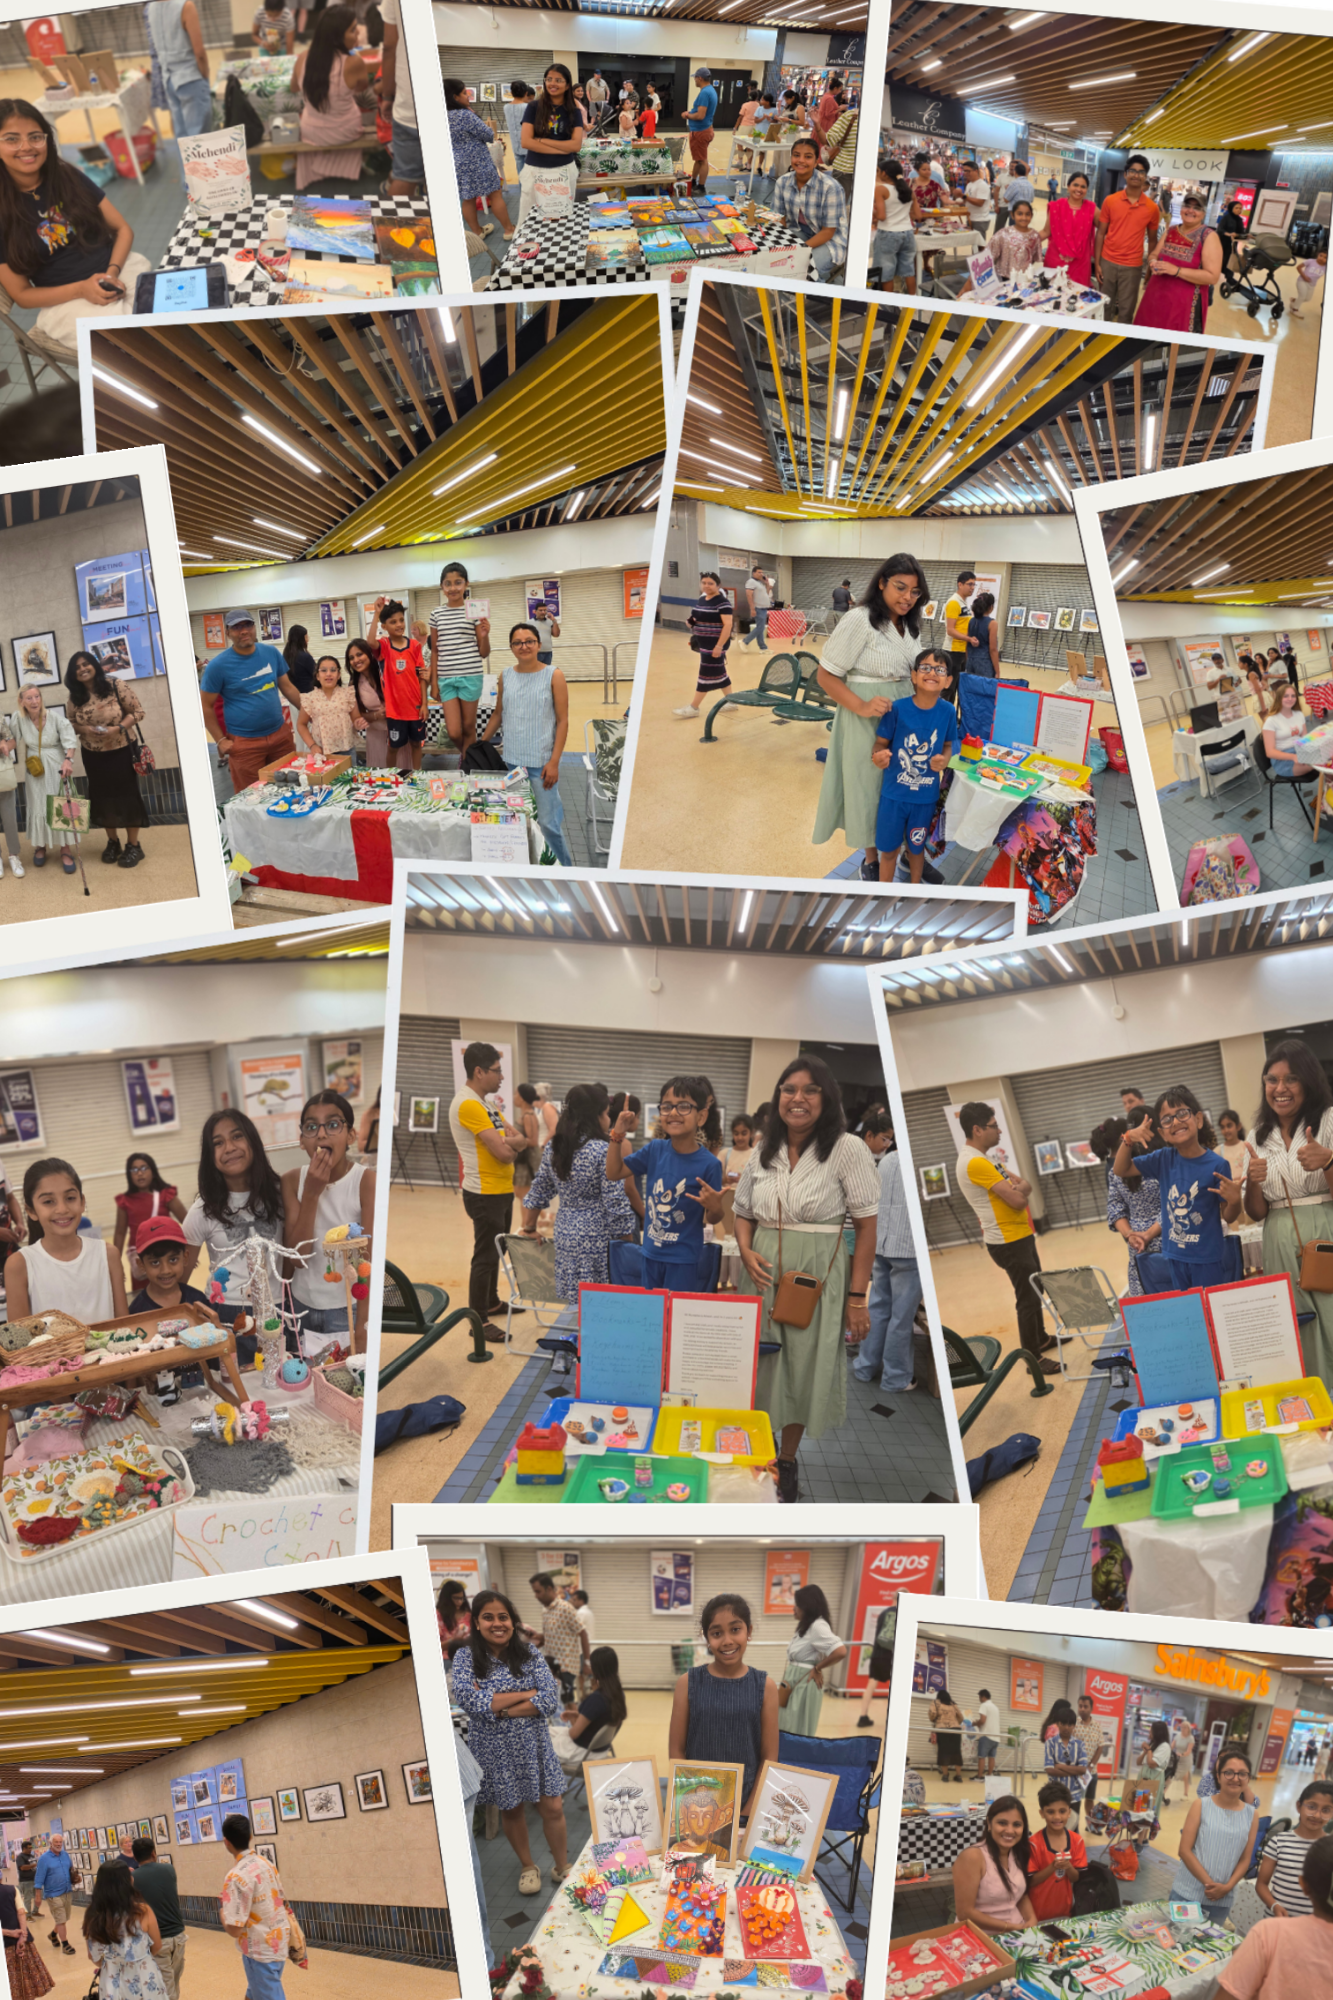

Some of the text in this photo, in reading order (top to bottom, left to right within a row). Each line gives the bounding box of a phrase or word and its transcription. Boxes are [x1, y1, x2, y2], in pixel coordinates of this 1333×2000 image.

[892, 116, 966, 140] Leather Company
[191, 142, 237, 159] Mehendi
[1172, 159, 1223, 171] LOOK
[92, 561, 123, 573] MEETING
[106, 625, 130, 635] FUN
[202, 1503, 323, 1544] Crochet
[869, 1550, 930, 1575] Argos
[1154, 1643, 1271, 1700] Sainsbury's
[1090, 1675, 1124, 1694] Argos
